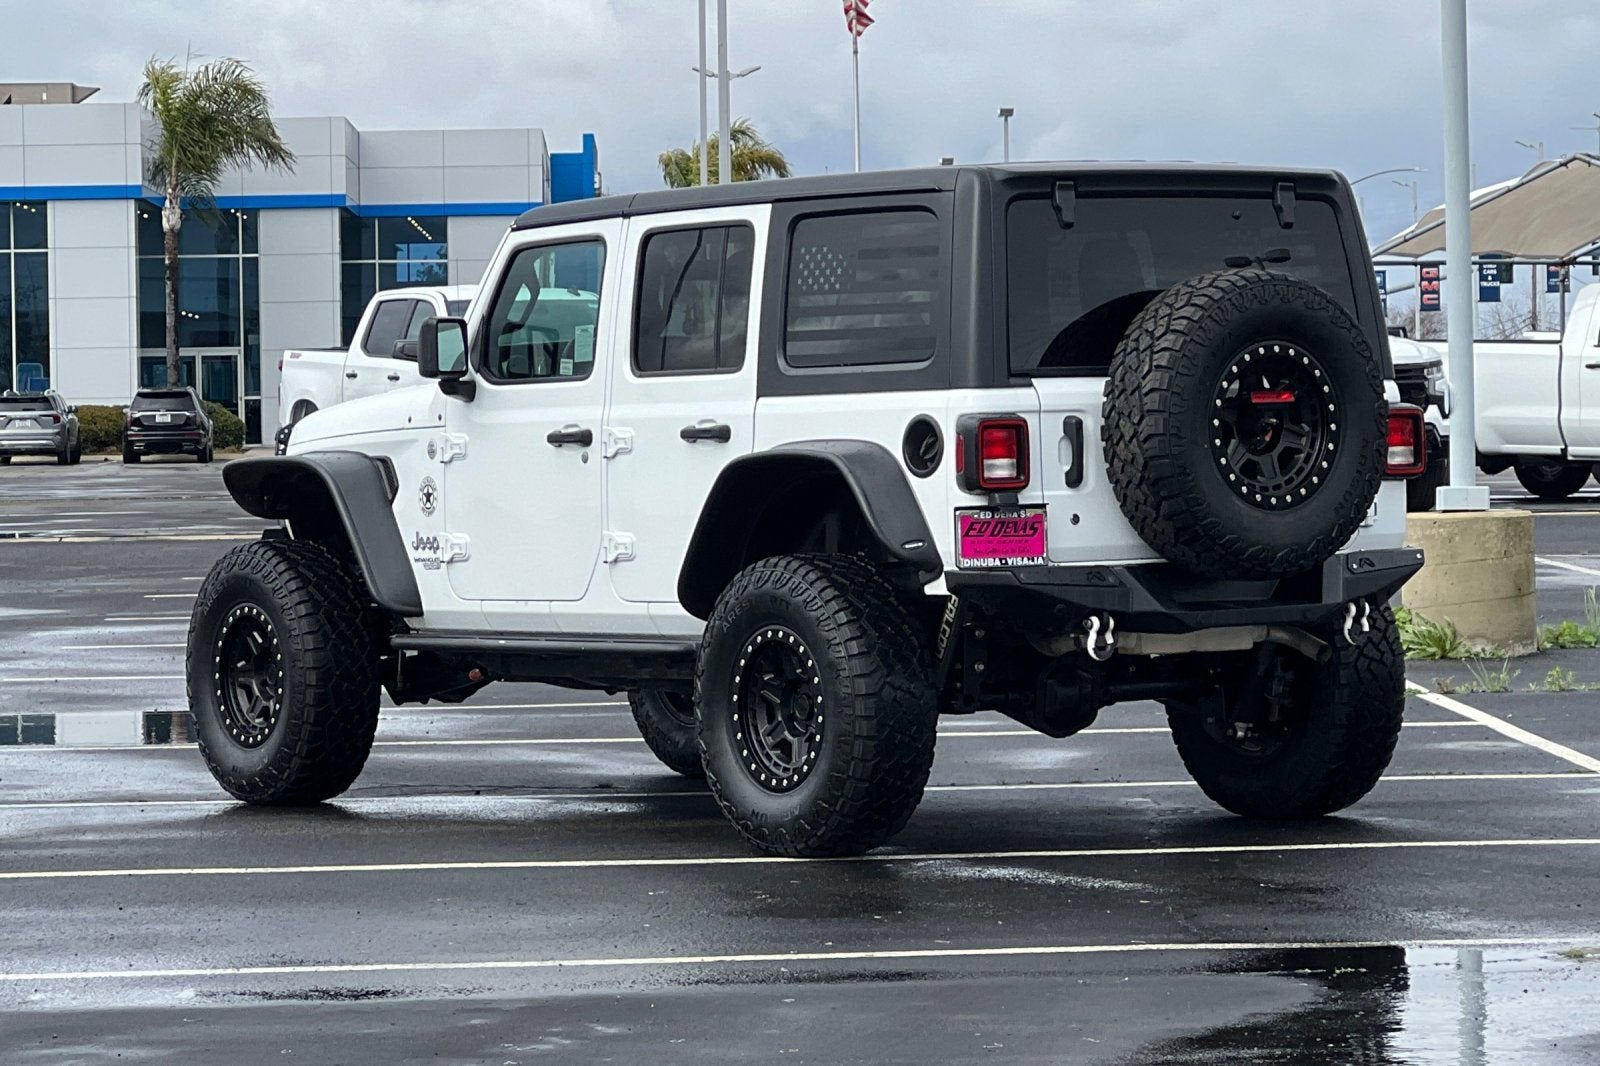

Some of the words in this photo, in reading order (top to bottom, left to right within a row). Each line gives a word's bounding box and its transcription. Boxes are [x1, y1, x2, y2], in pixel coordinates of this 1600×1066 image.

[1421, 267, 1439, 304] GMC
[980, 511, 992, 519] ED
[962, 520, 991, 537] ED
[411, 531, 440, 555] Jeep
[963, 557, 1001, 567] DINUBA
[1006, 556, 1044, 566] VISALIA
